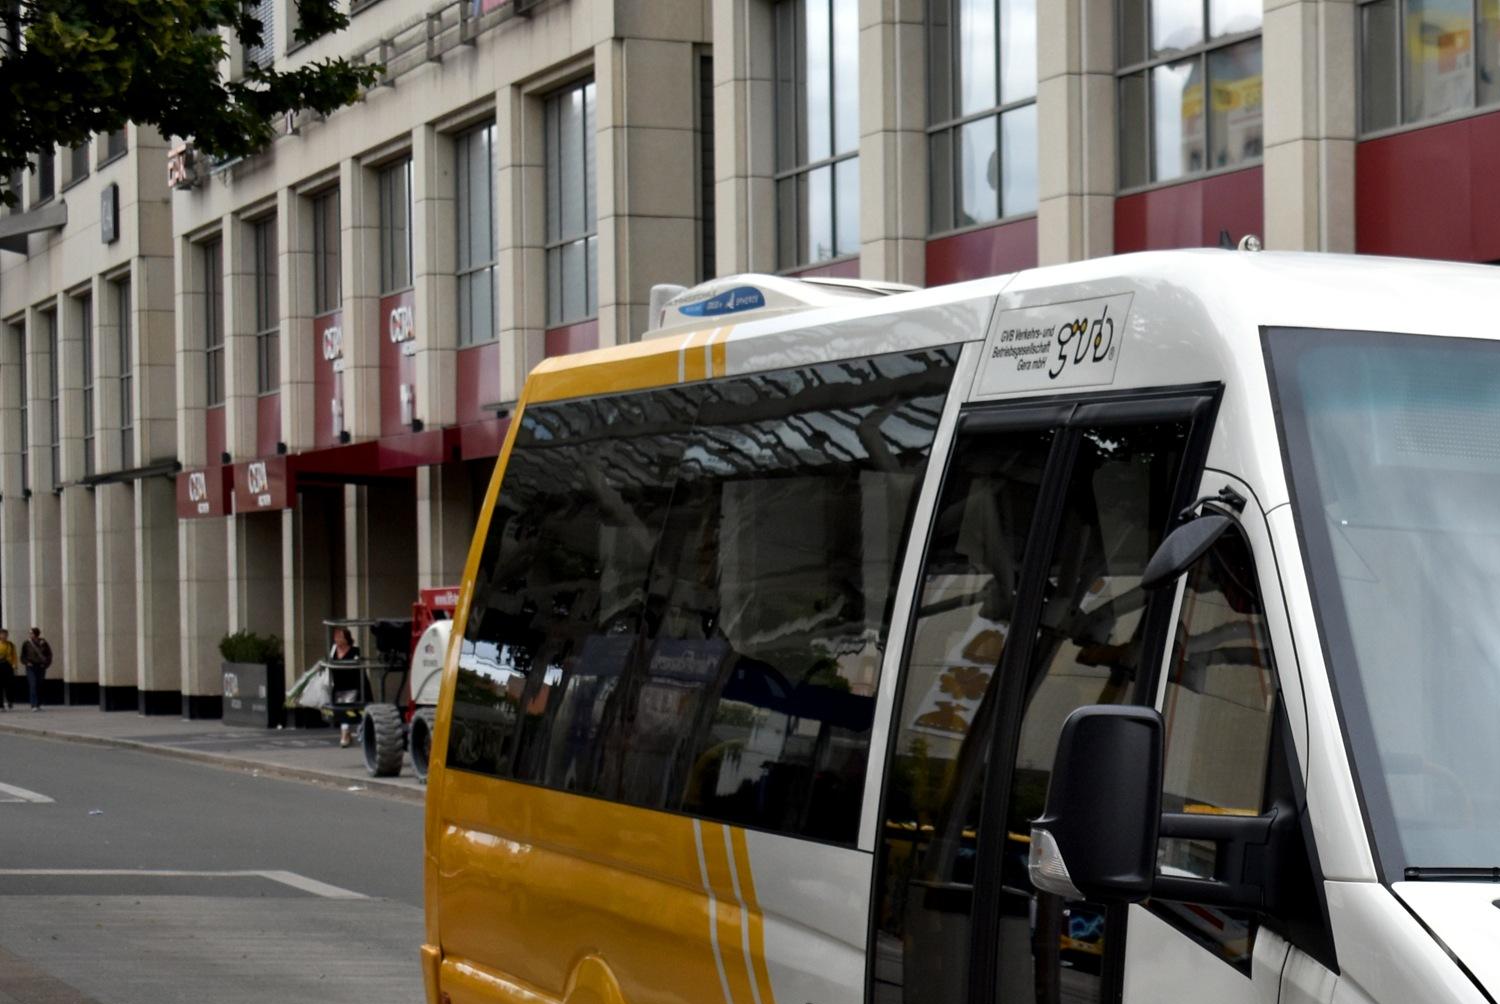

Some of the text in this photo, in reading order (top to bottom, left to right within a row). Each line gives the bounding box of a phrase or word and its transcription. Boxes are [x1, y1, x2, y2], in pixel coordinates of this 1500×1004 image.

[1042, 324, 1056, 338] und
[1016, 356, 1048, 371] Gera mbH
